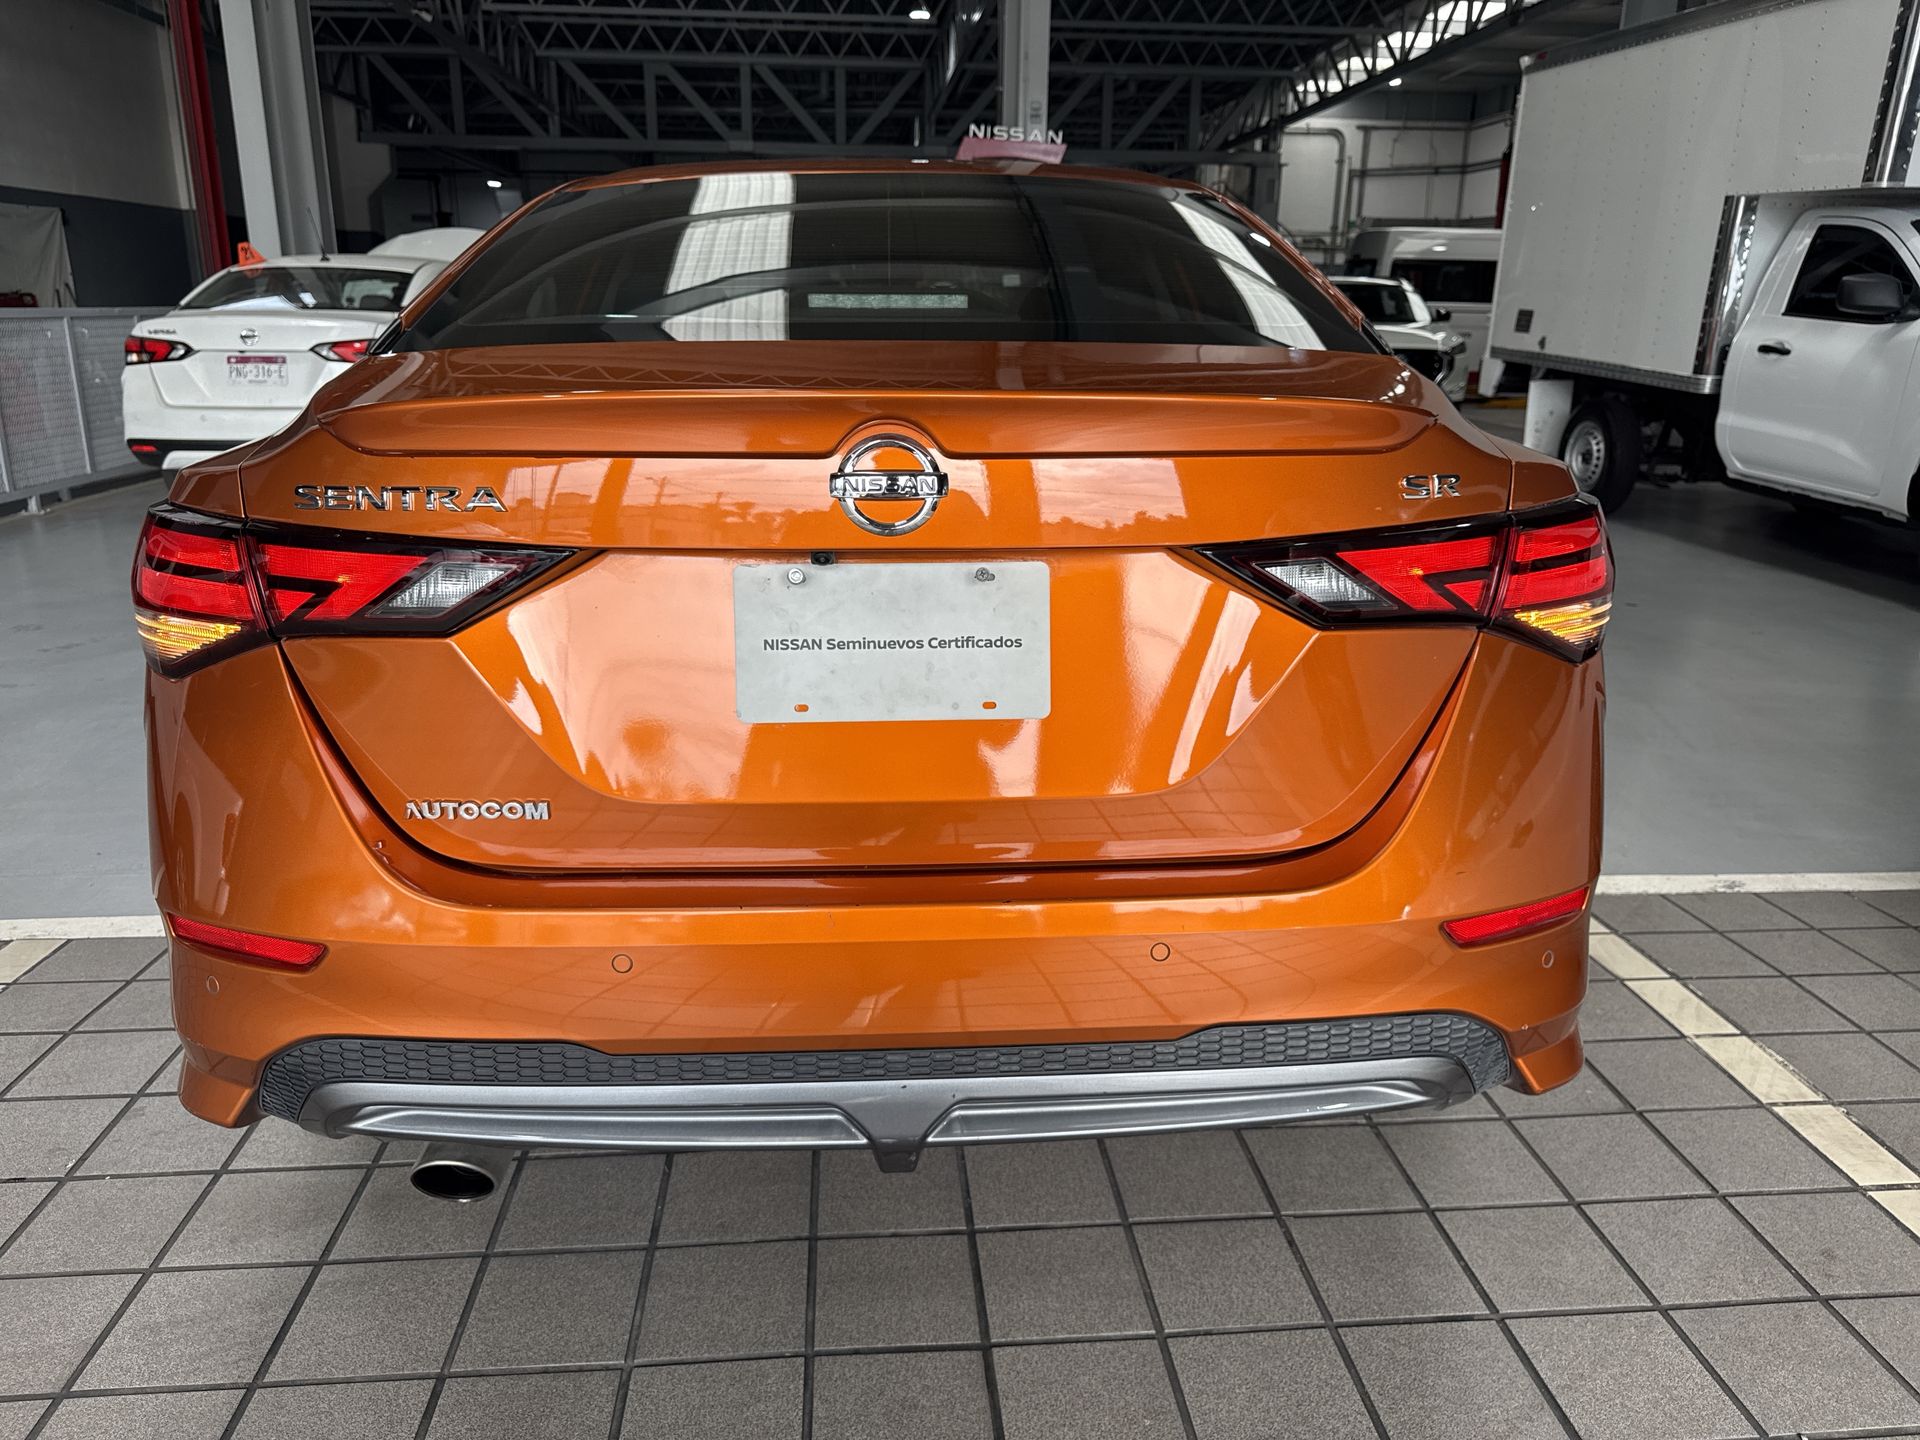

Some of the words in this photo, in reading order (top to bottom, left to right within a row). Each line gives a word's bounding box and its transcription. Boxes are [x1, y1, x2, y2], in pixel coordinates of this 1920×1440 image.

[968, 123, 1063, 144] NISSAN
[842, 475, 938, 494] NISSAN
[1400, 474, 1461, 499] SR
[294, 485, 509, 512] SENTRA
[763, 638, 822, 651] NISSAN
[826, 637, 924, 650] Seminuevos
[927, 636, 1023, 649] Certificados
[405, 800, 551, 821] AUTOCOM
